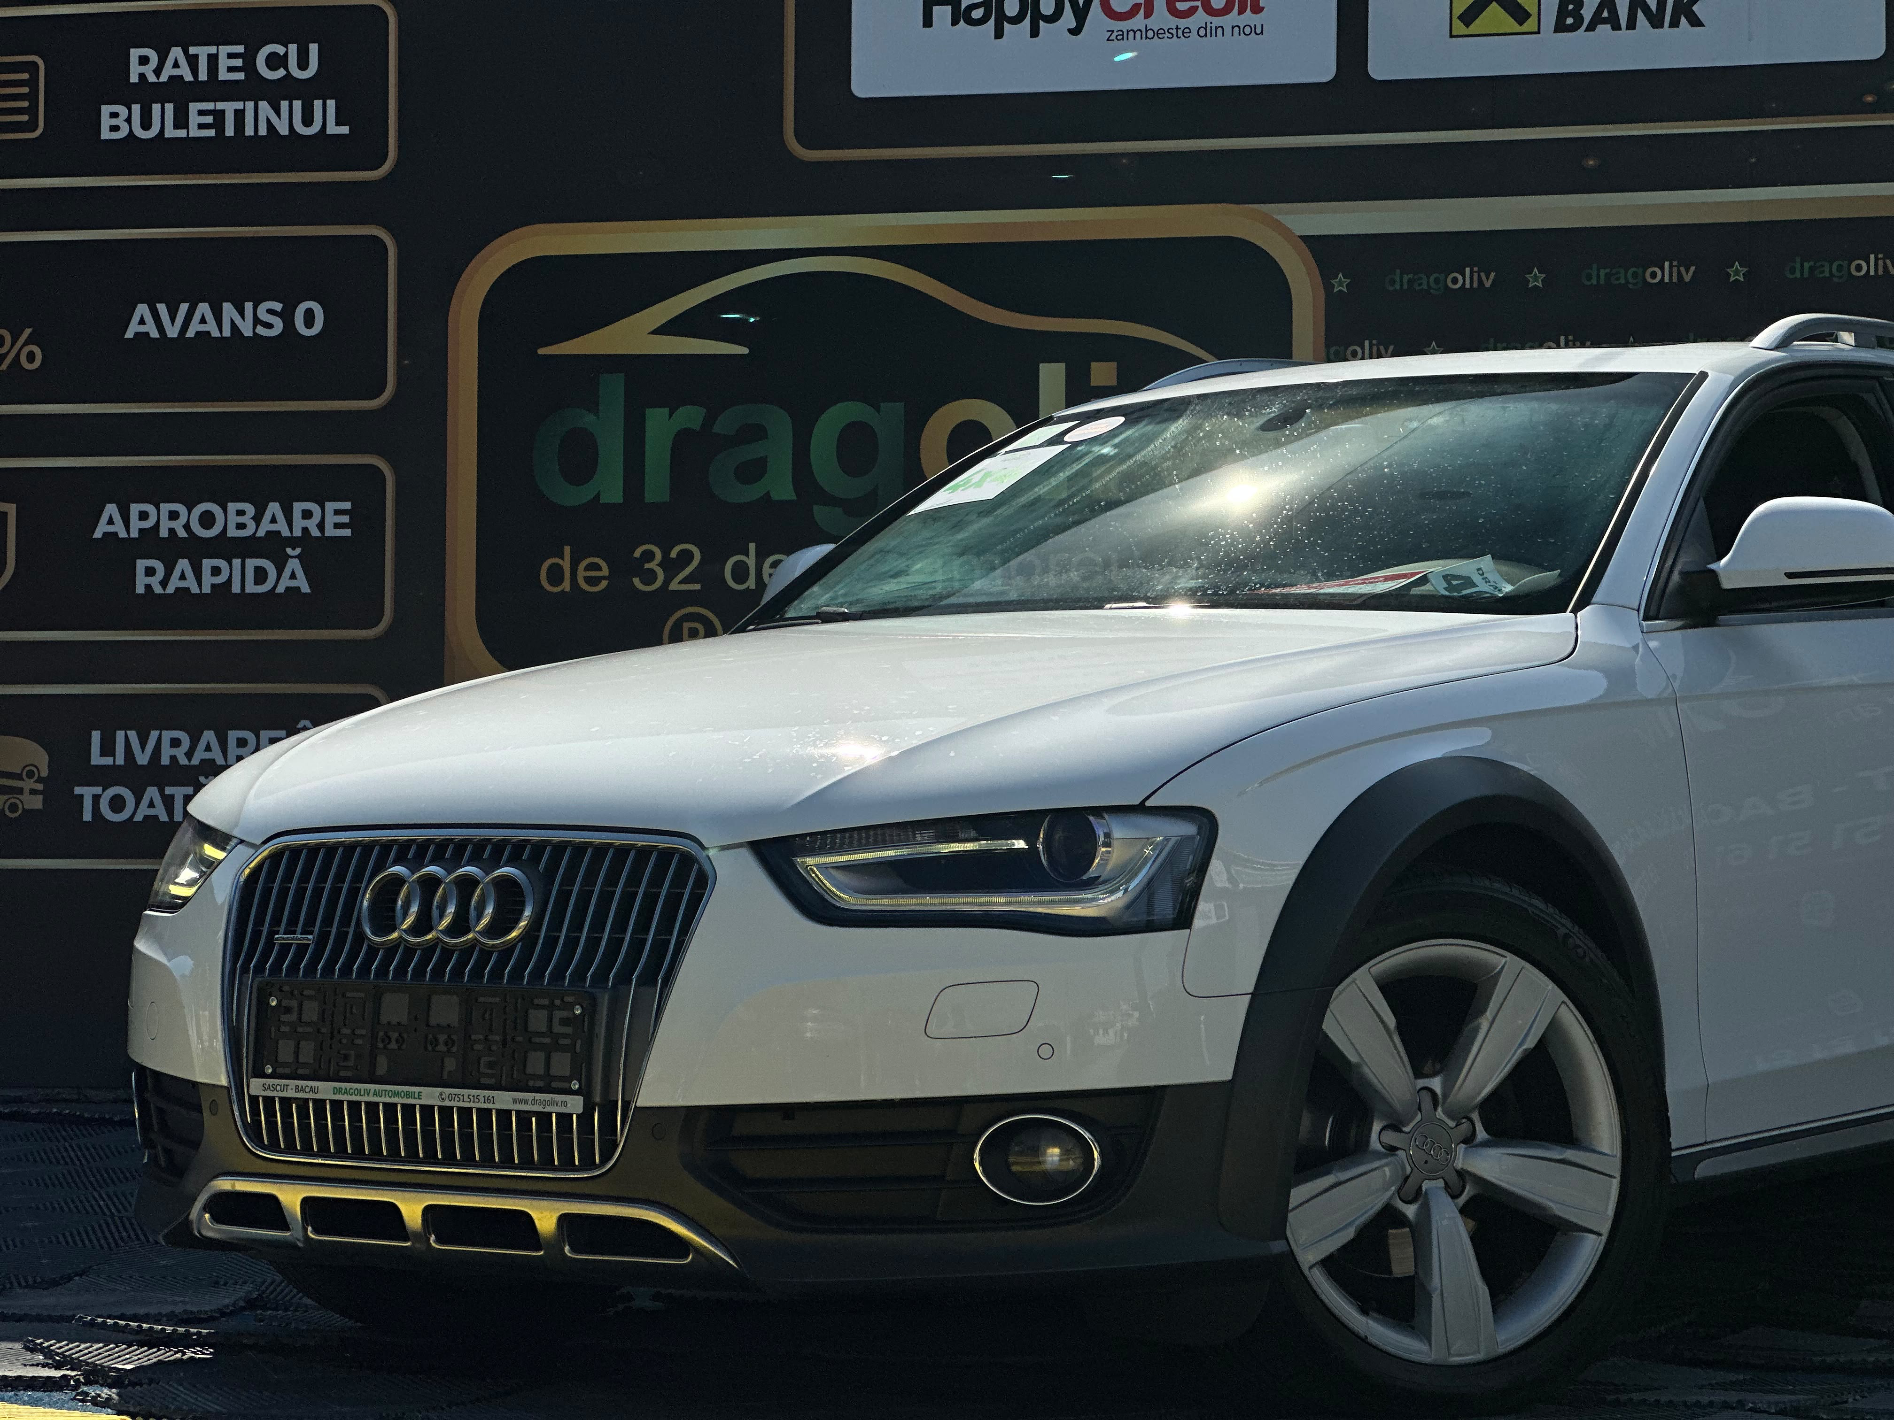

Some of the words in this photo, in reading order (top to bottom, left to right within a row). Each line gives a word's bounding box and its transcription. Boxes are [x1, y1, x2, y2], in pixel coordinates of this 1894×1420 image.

[1106, 25, 1191, 42] zambeste
[1196, 24, 1226, 39] din
[1231, 23, 1265, 38] nou
[1553, 0, 1706, 34] BANK
[129, 45, 245, 83] RATE
[256, 43, 319, 80] CU
[100, 99, 350, 140] BULETINUL
[1385, 267, 1496, 294] dragoliv
[1582, 262, 1696, 290] dragoliv
[124, 301, 284, 339] AVANS
[92, 501, 352, 539] APROBARE
[136, 547, 311, 594] RAPIDĂ
[539, 545, 609, 593] de
[631, 543, 702, 591] 32
[74, 775, 214, 822] TOAT
[332, 1086, 371, 1098] DRAGOLIV
[372, 1089, 423, 1100] AUTOMOBILE
[511, 1095, 568, 1110] www.dragoliv.ro
